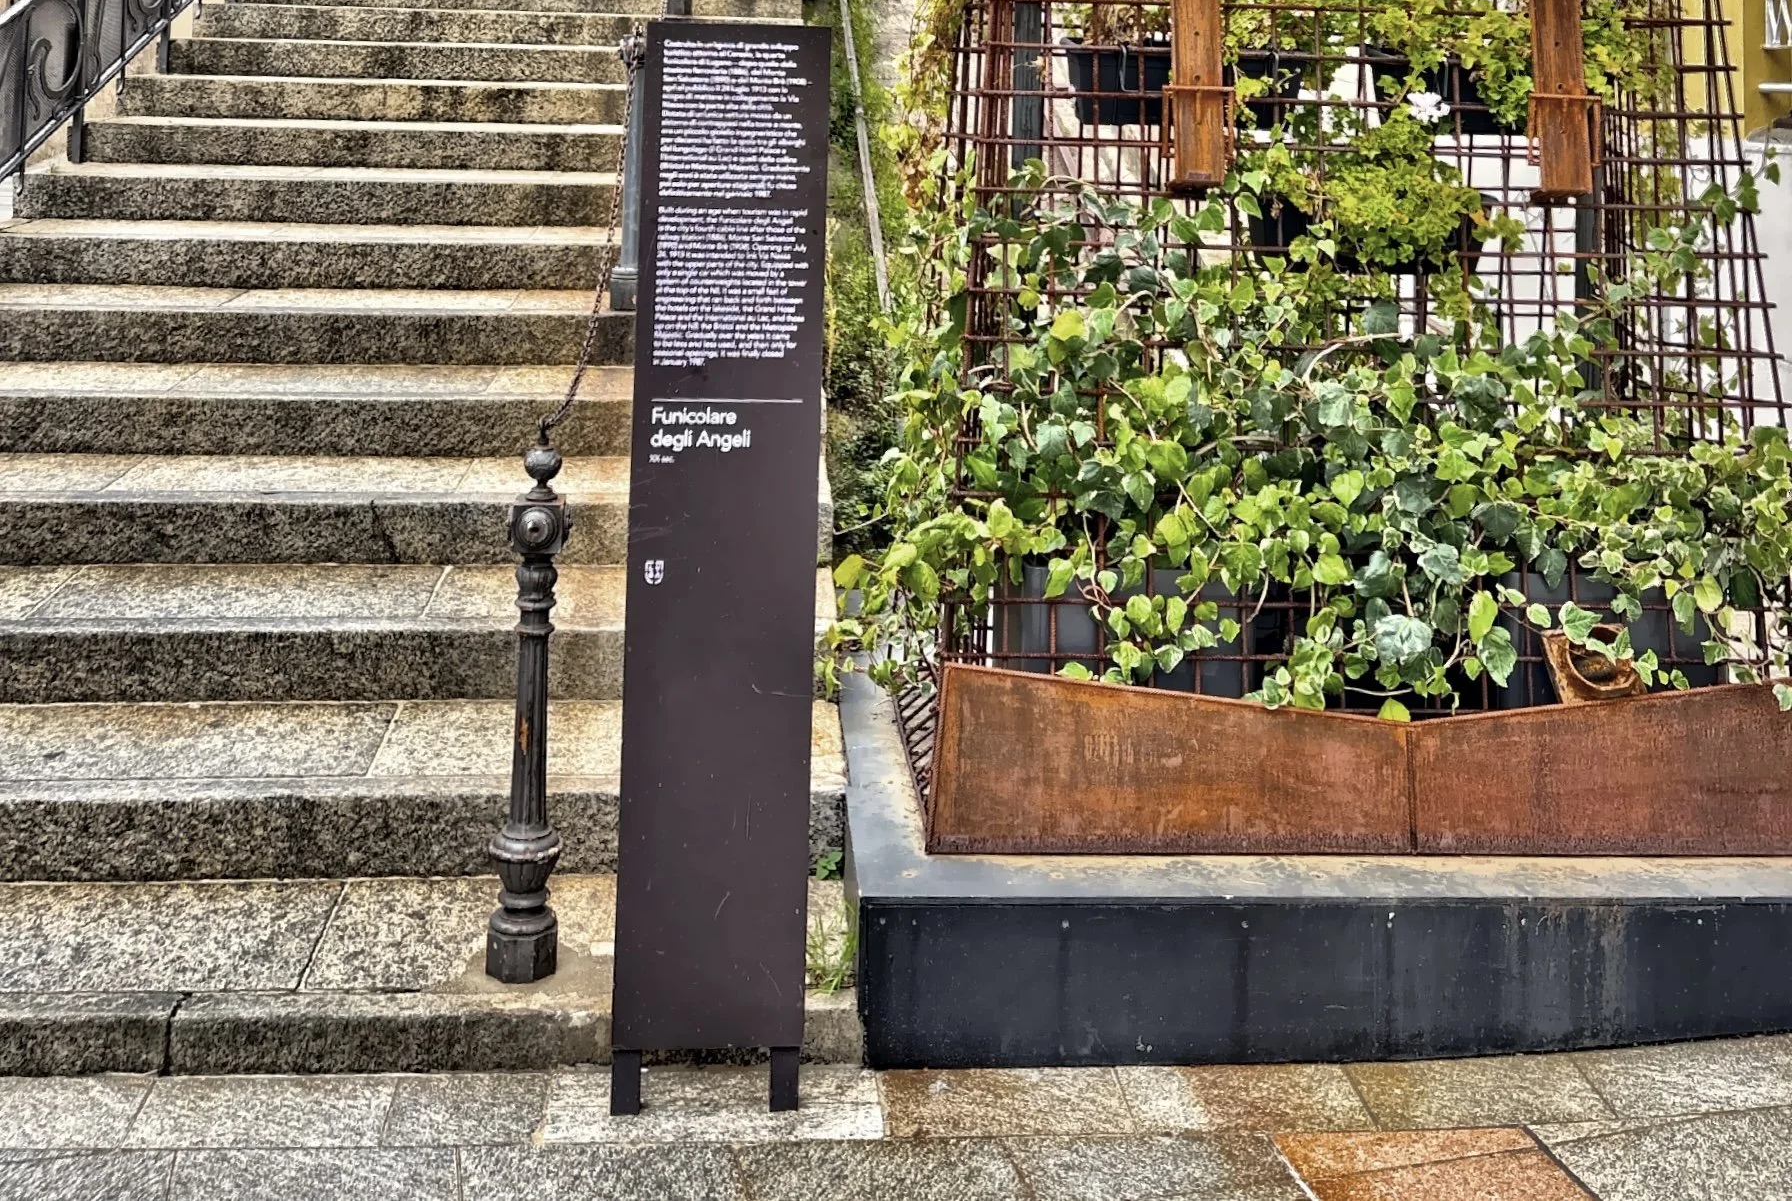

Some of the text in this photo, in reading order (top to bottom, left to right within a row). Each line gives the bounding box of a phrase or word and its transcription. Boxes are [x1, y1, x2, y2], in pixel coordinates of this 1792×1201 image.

[651, 407, 737, 425] Funicolare
[650, 428, 751, 452] degli Angeli
